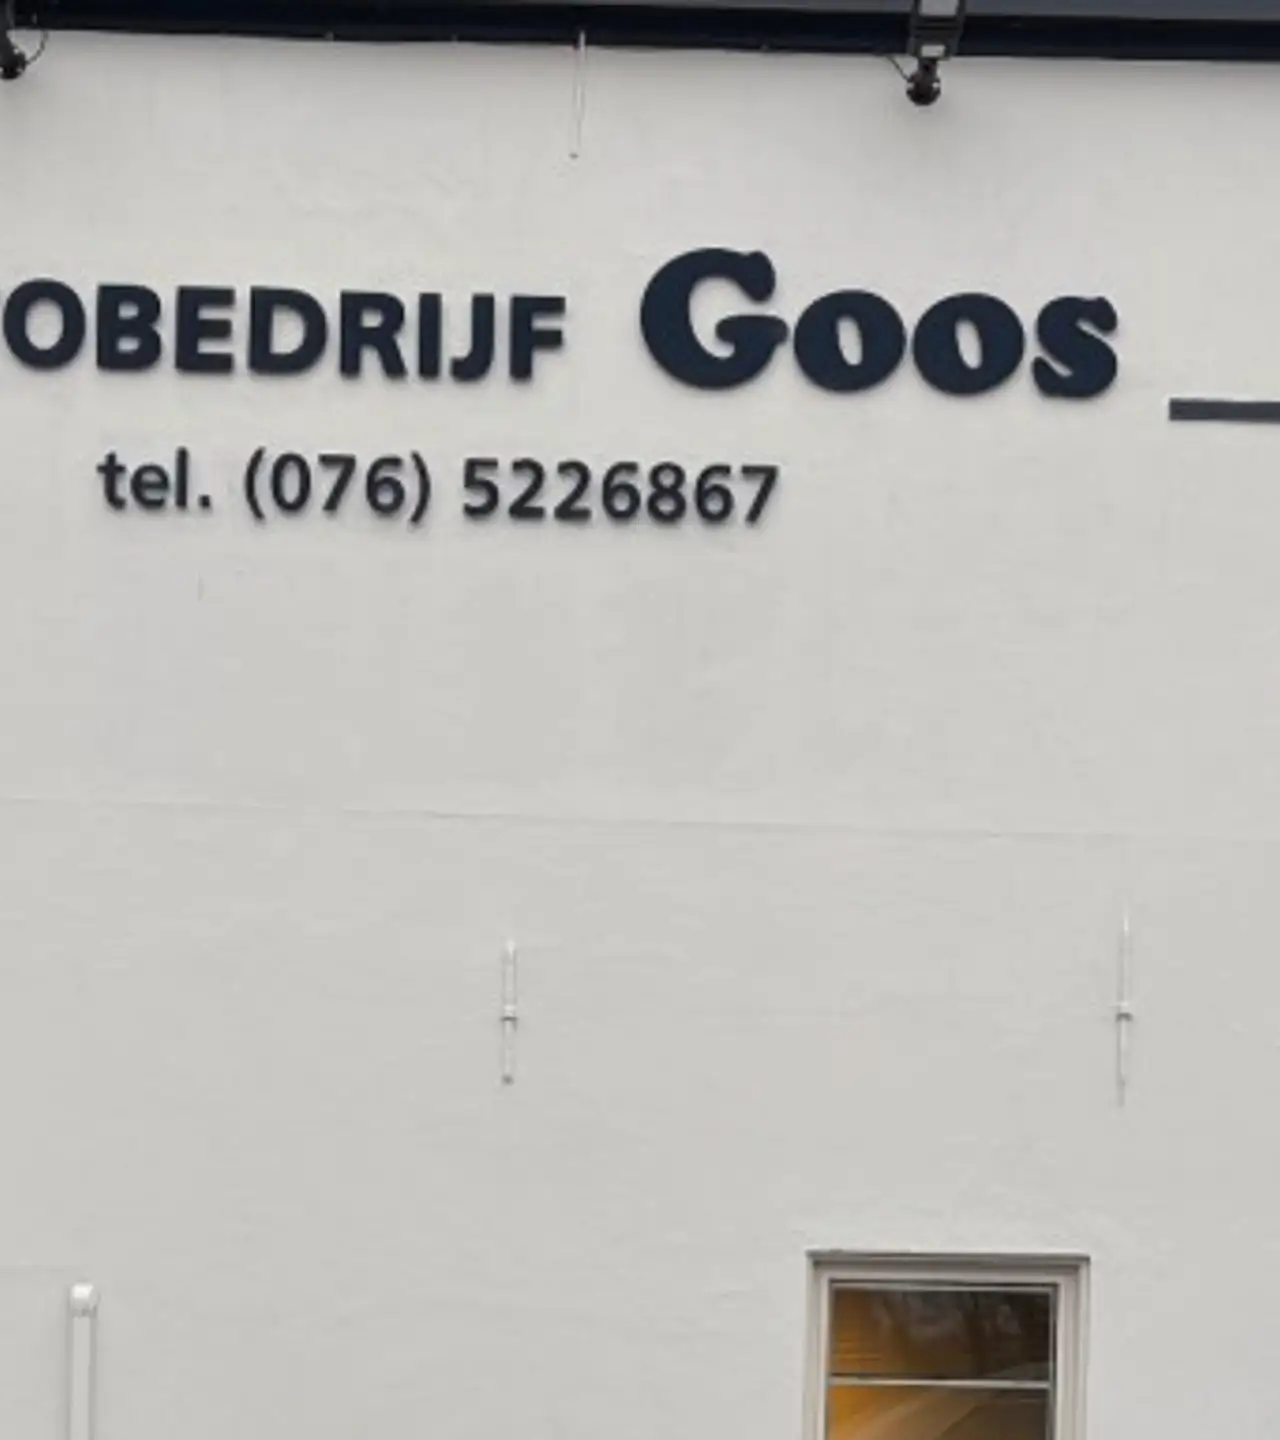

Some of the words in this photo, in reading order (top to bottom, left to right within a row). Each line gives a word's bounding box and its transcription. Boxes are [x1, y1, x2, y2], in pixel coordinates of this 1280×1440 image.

[97, 448, 211, 512] tel.
[245, 448, 431, 525] (076)
[464, 458, 778, 526] 5226867
